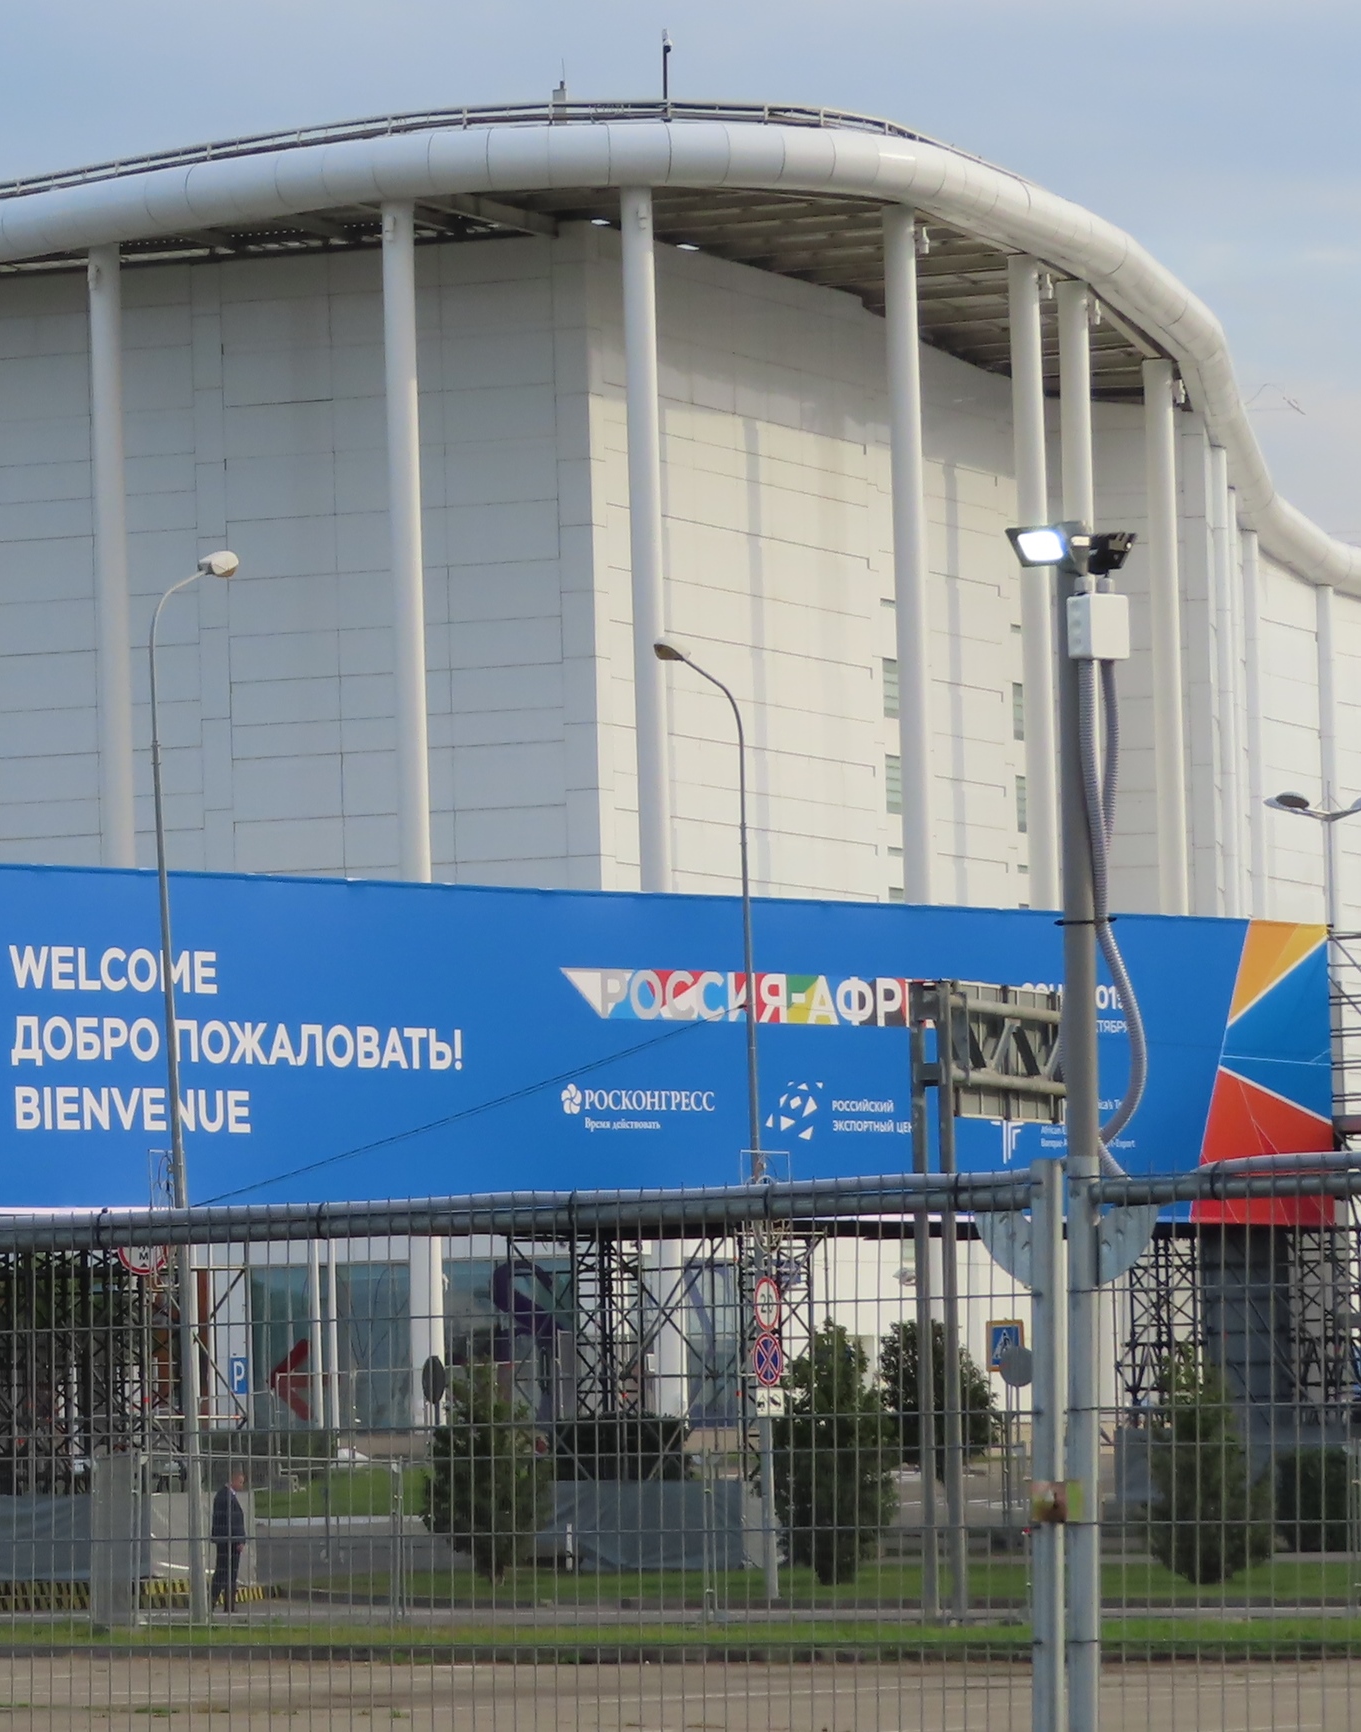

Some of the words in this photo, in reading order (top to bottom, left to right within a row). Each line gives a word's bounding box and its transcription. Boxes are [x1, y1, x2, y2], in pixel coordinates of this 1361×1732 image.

[9, 944, 218, 994] WELCOME
[600, 968, 936, 1027] РОССИЯ-АФР
[11, 1015, 159, 1066] ДОБРО
[175, 1020, 463, 1071] ПОЖАЛОВАТЬ!
[15, 1086, 251, 1133] BIENVENUE
[585, 1090, 715, 1112] РОСКОНГРЕСС
[832, 1099, 894, 1113] РОССИЙСКИЙ
[585, 1117, 610, 1132] Время
[612, 1118, 661, 1130] действовать
[833, 1119, 894, 1132] ЭКСПОРТНЫЙ
[233, 1361, 245, 1391] P
